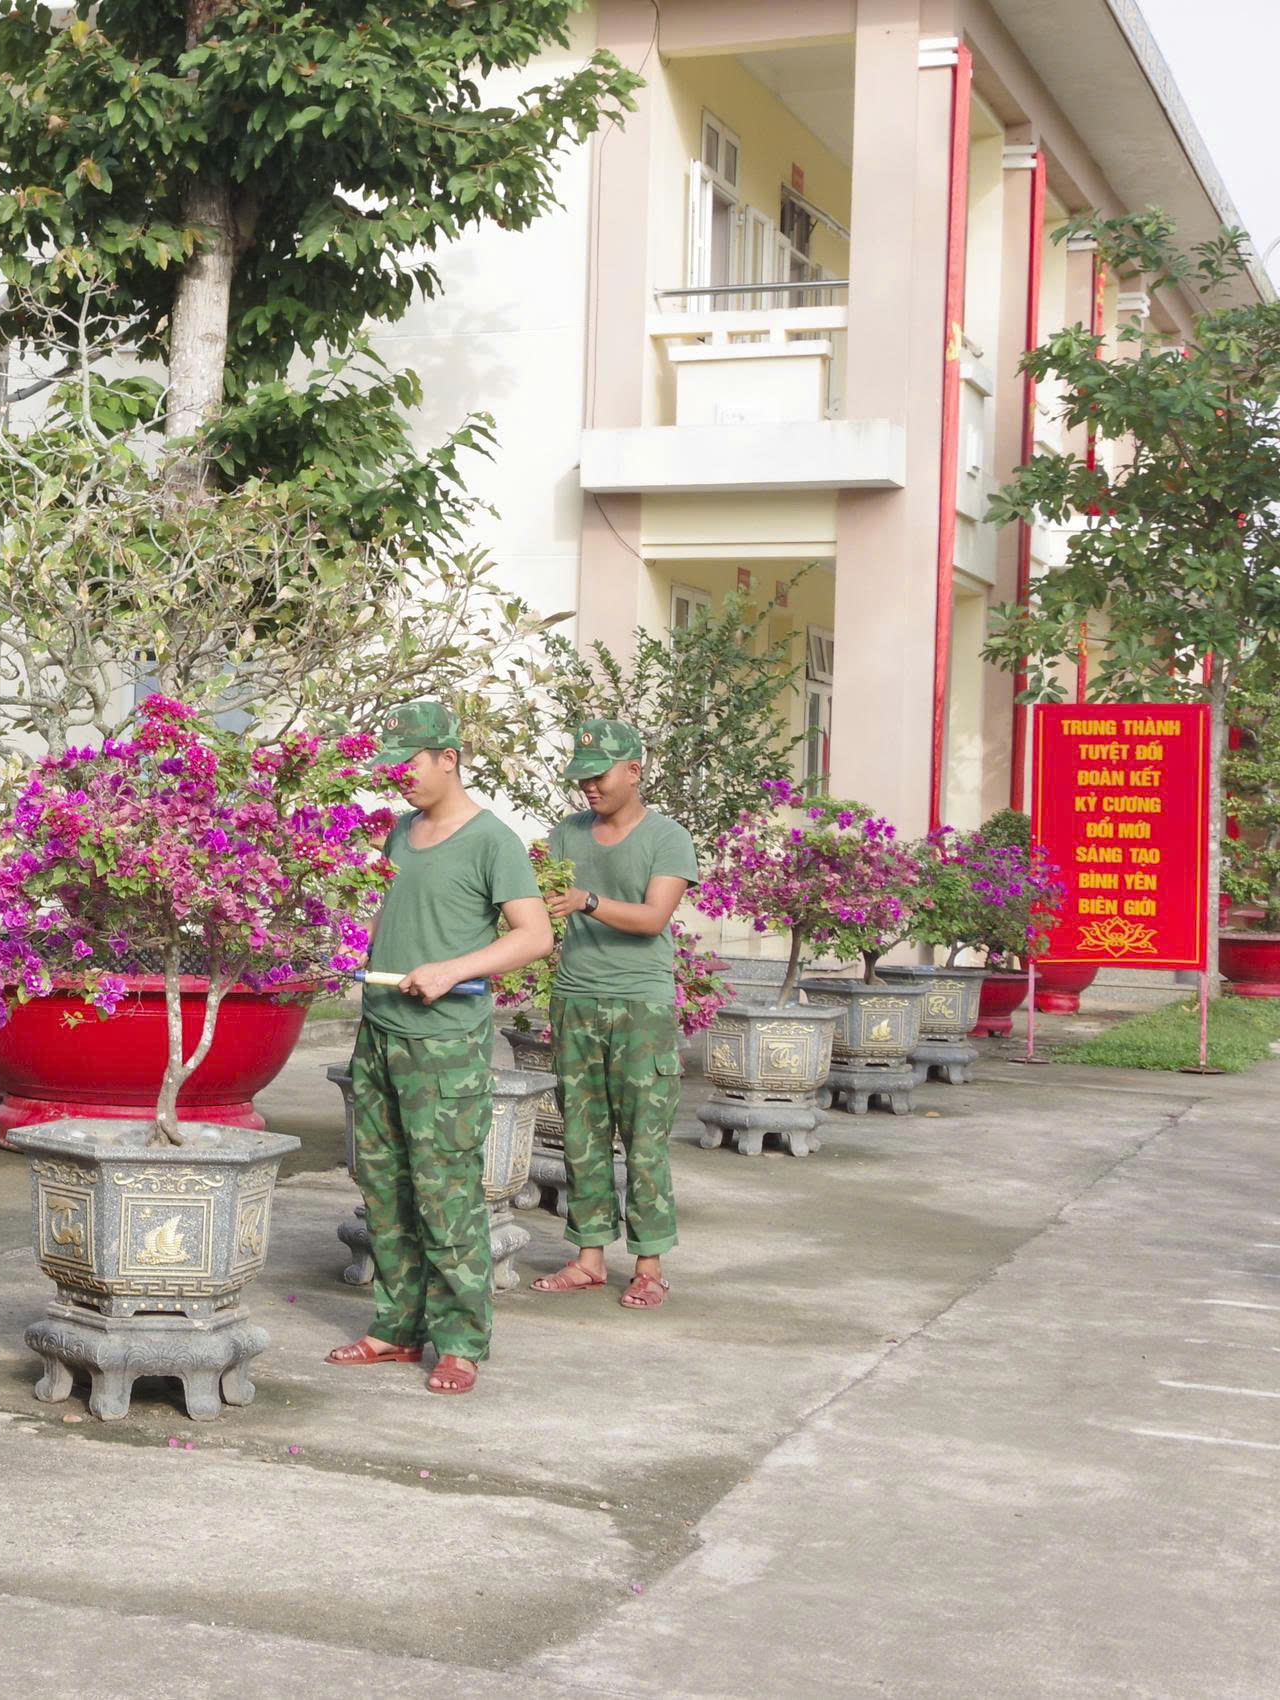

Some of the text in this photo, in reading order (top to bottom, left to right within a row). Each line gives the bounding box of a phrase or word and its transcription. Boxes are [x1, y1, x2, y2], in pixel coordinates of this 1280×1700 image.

[1062, 717, 1180, 735] TRUNG THÀNH
[1079, 741, 1163, 763] TUYỆT ĐỐI
[1077, 766, 1161, 786] ĐOÀN KẾT
[1075, 792, 1161, 813] KỶ CƯƠNG
[1086, 816, 1150, 838] ĐỔI MỚI
[1076, 844, 1160, 867] SÁNG TẠO
[1079, 870, 1157, 890] BÌNH YÊN
[1079, 896, 1156, 916] BIÊN GIỚI
